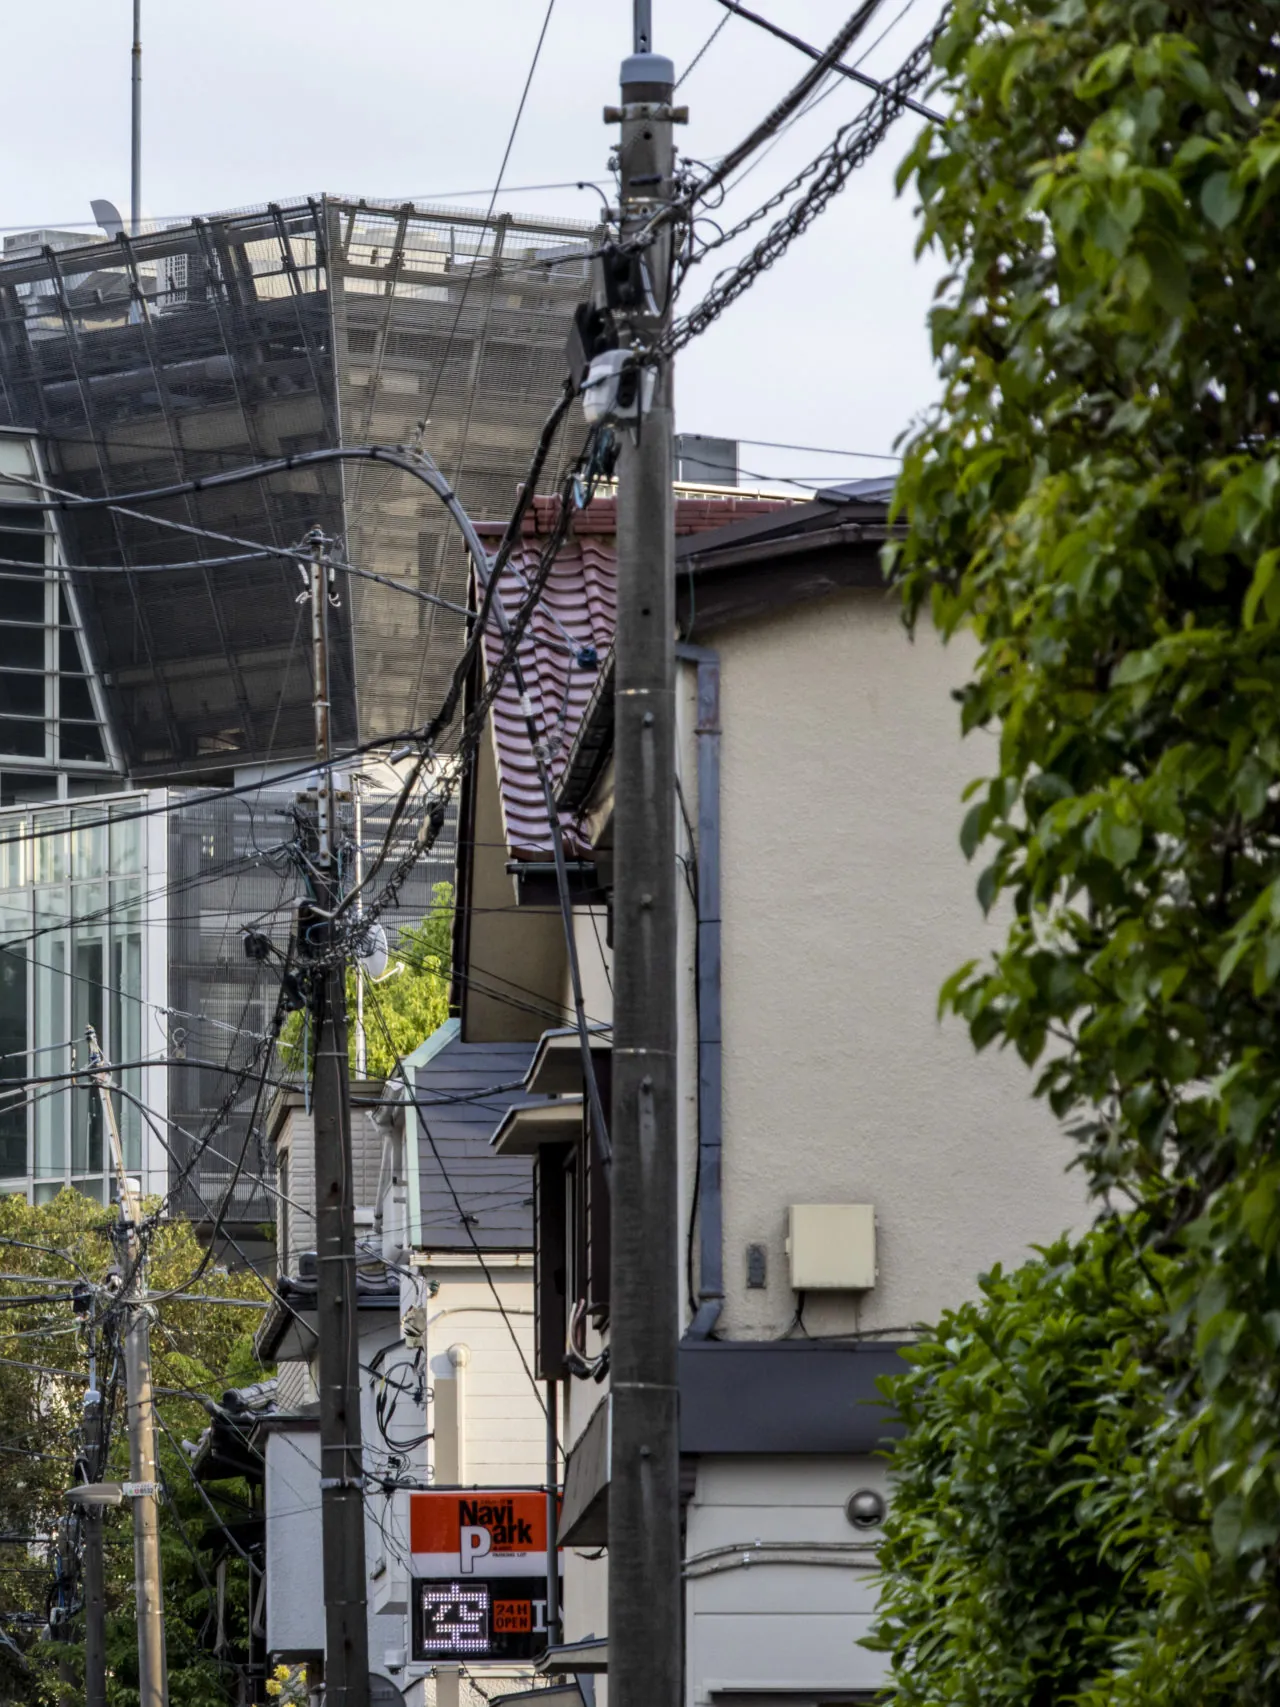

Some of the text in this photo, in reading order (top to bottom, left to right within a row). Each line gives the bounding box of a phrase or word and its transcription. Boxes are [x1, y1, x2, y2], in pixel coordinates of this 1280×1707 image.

[459, 1499, 513, 1526] Navi
[423, 1583, 489, 1651] 空
[496, 1616, 528, 1629] OPEN
